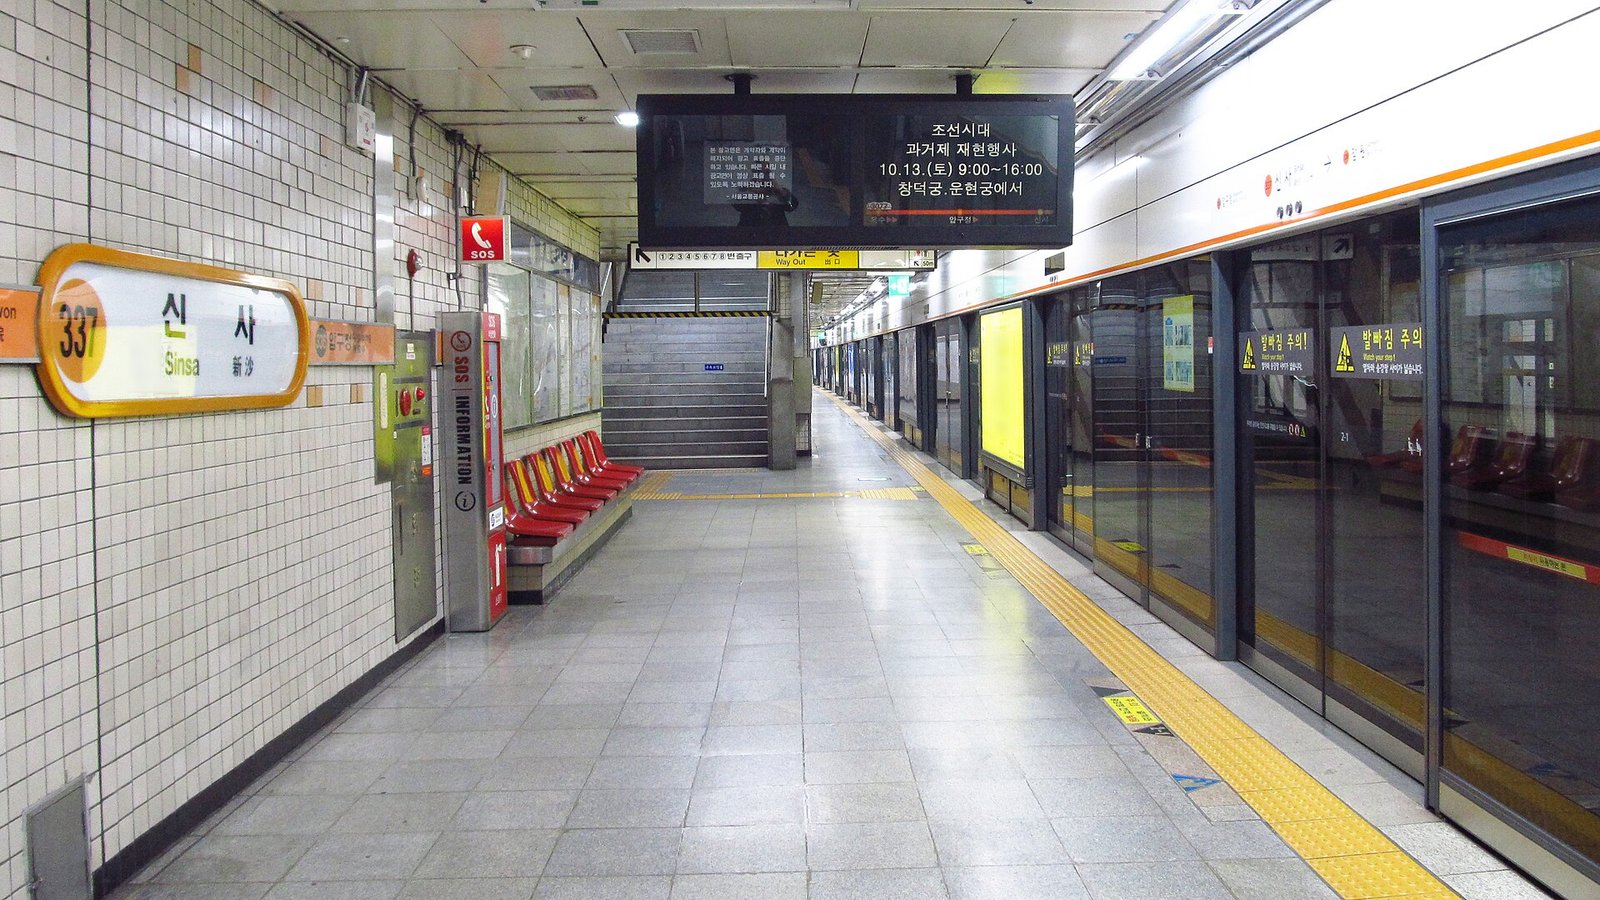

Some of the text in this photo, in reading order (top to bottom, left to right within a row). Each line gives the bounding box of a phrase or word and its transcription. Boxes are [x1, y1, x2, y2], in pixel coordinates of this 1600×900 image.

[931, 123, 991, 138] 조선시대
[905, 142, 1017, 157] 과거제 재현행사
[879, 161, 1043, 177] 10.13.(토) 9:00~16:00
[898, 181, 1023, 196] 창덕궁.운현궁에서
[949, 216, 972, 224] 압구정
[470, 250, 496, 259] SOS
[775, 258, 806, 267] Way Out
[59, 303, 98, 358] 337
[1260, 332, 1308, 352] 발빠짐 주의!
[1362, 326, 1422, 351] 발빠짐 주의
[164, 350, 200, 377] Sinsa
[454, 356, 470, 383] SOS
[455, 395, 472, 485] INFORMATION
[1340, 431, 1349, 443] 2-1
